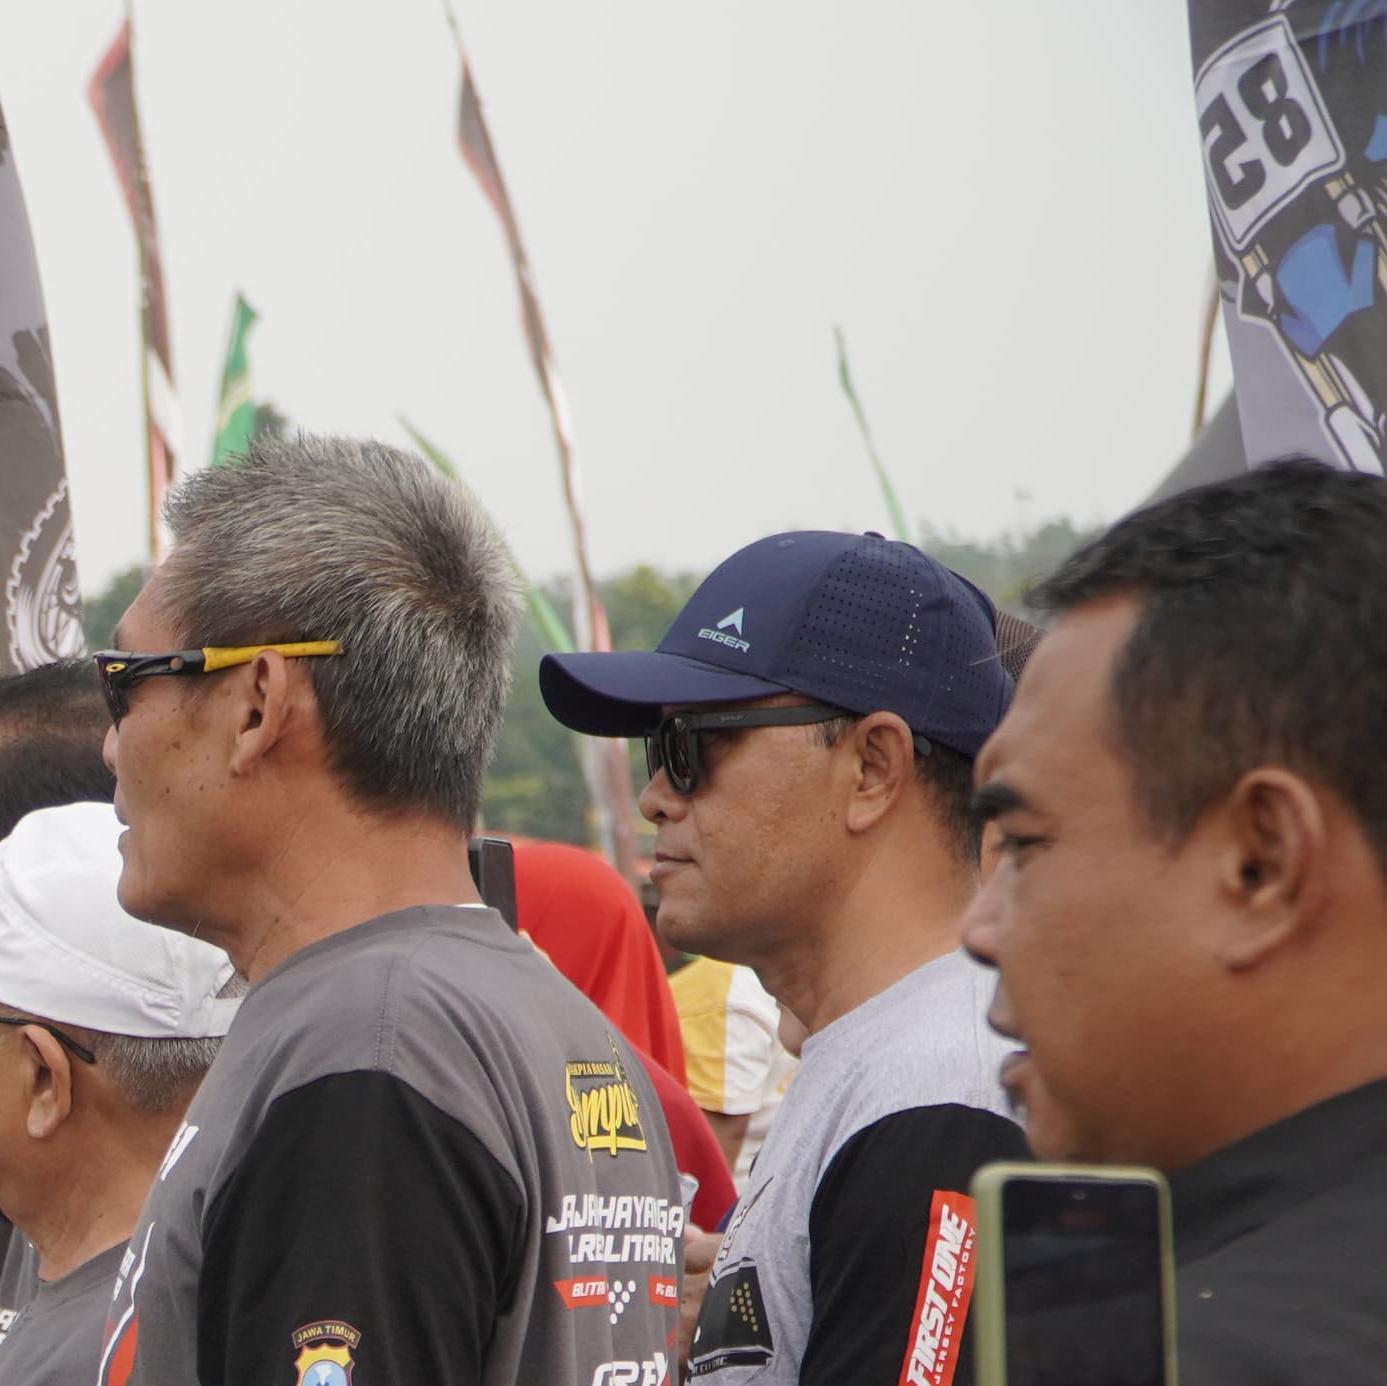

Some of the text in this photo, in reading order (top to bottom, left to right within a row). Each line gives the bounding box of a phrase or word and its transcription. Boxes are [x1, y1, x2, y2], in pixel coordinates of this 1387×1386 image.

[698, 628, 750, 653] EIGER
[931, 1203, 968, 1292] ONE
[297, 1325, 357, 1343] JAWA TIMUR
[933, 1226, 977, 1385] JERSEY FACTORY
